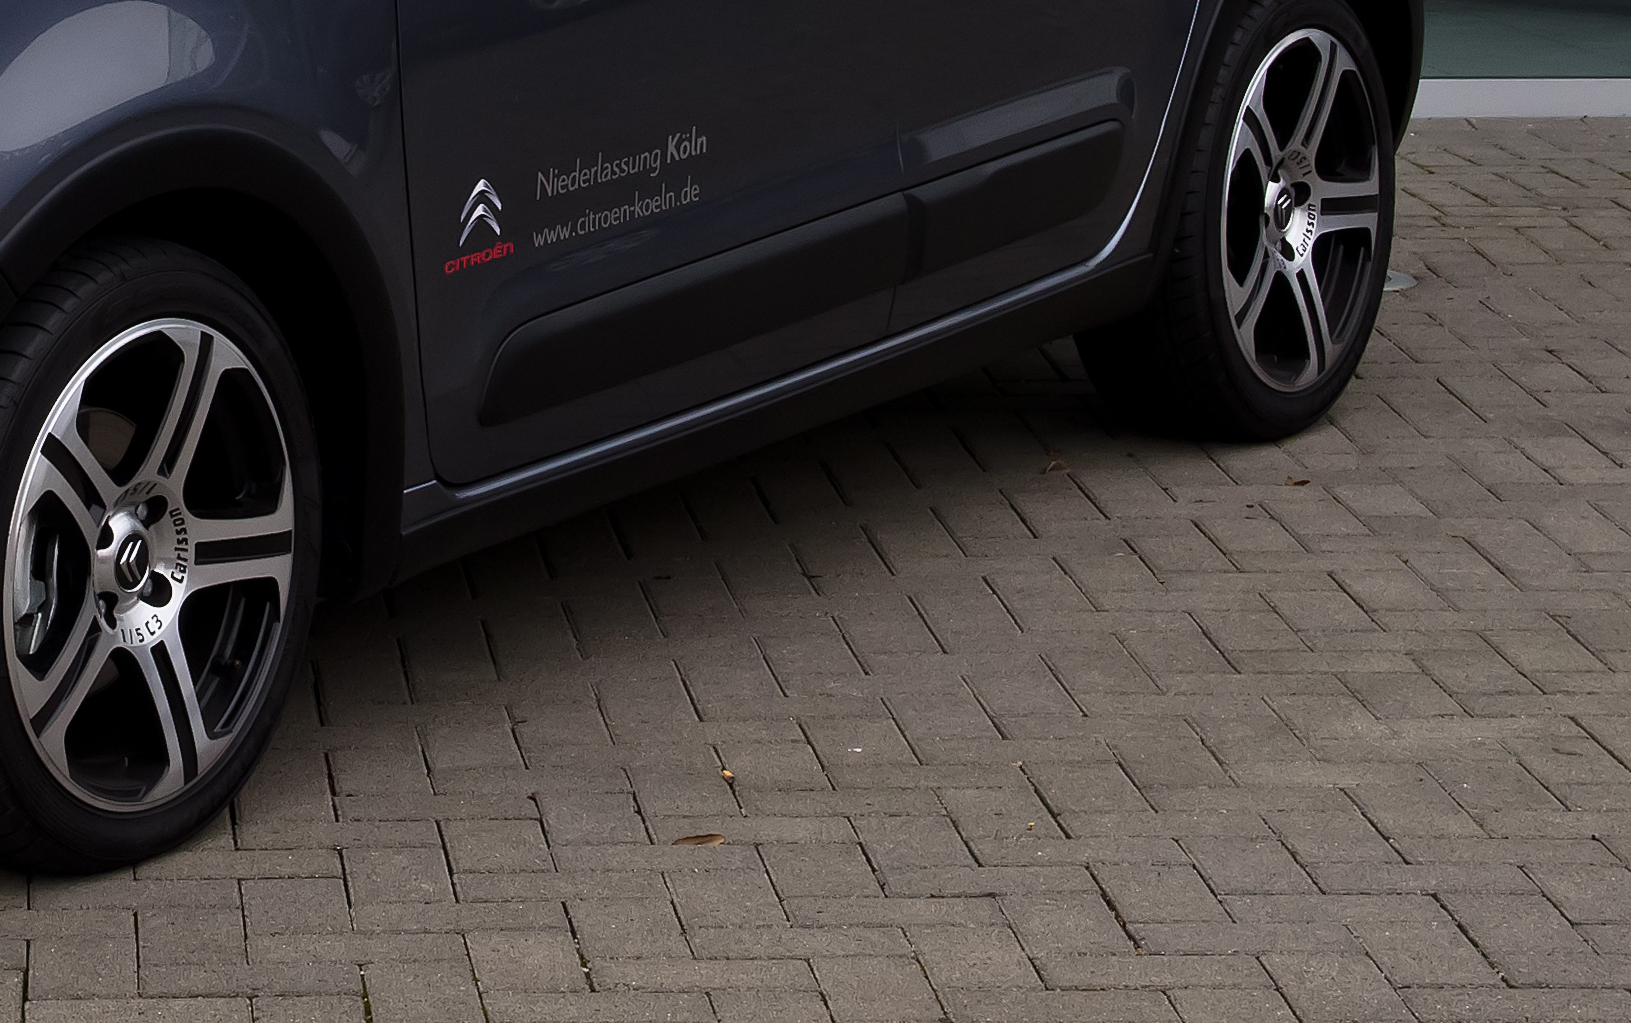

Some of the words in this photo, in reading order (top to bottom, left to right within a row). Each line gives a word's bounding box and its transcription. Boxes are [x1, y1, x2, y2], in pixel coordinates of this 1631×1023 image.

[535, 152, 661, 201] Niederlassung
[665, 125, 707, 164] Köln
[532, 175, 701, 248] www.citroen-koeln.de
[1295, 202, 1317, 258] Carlsson
[168, 507, 189, 584] Carlsson
